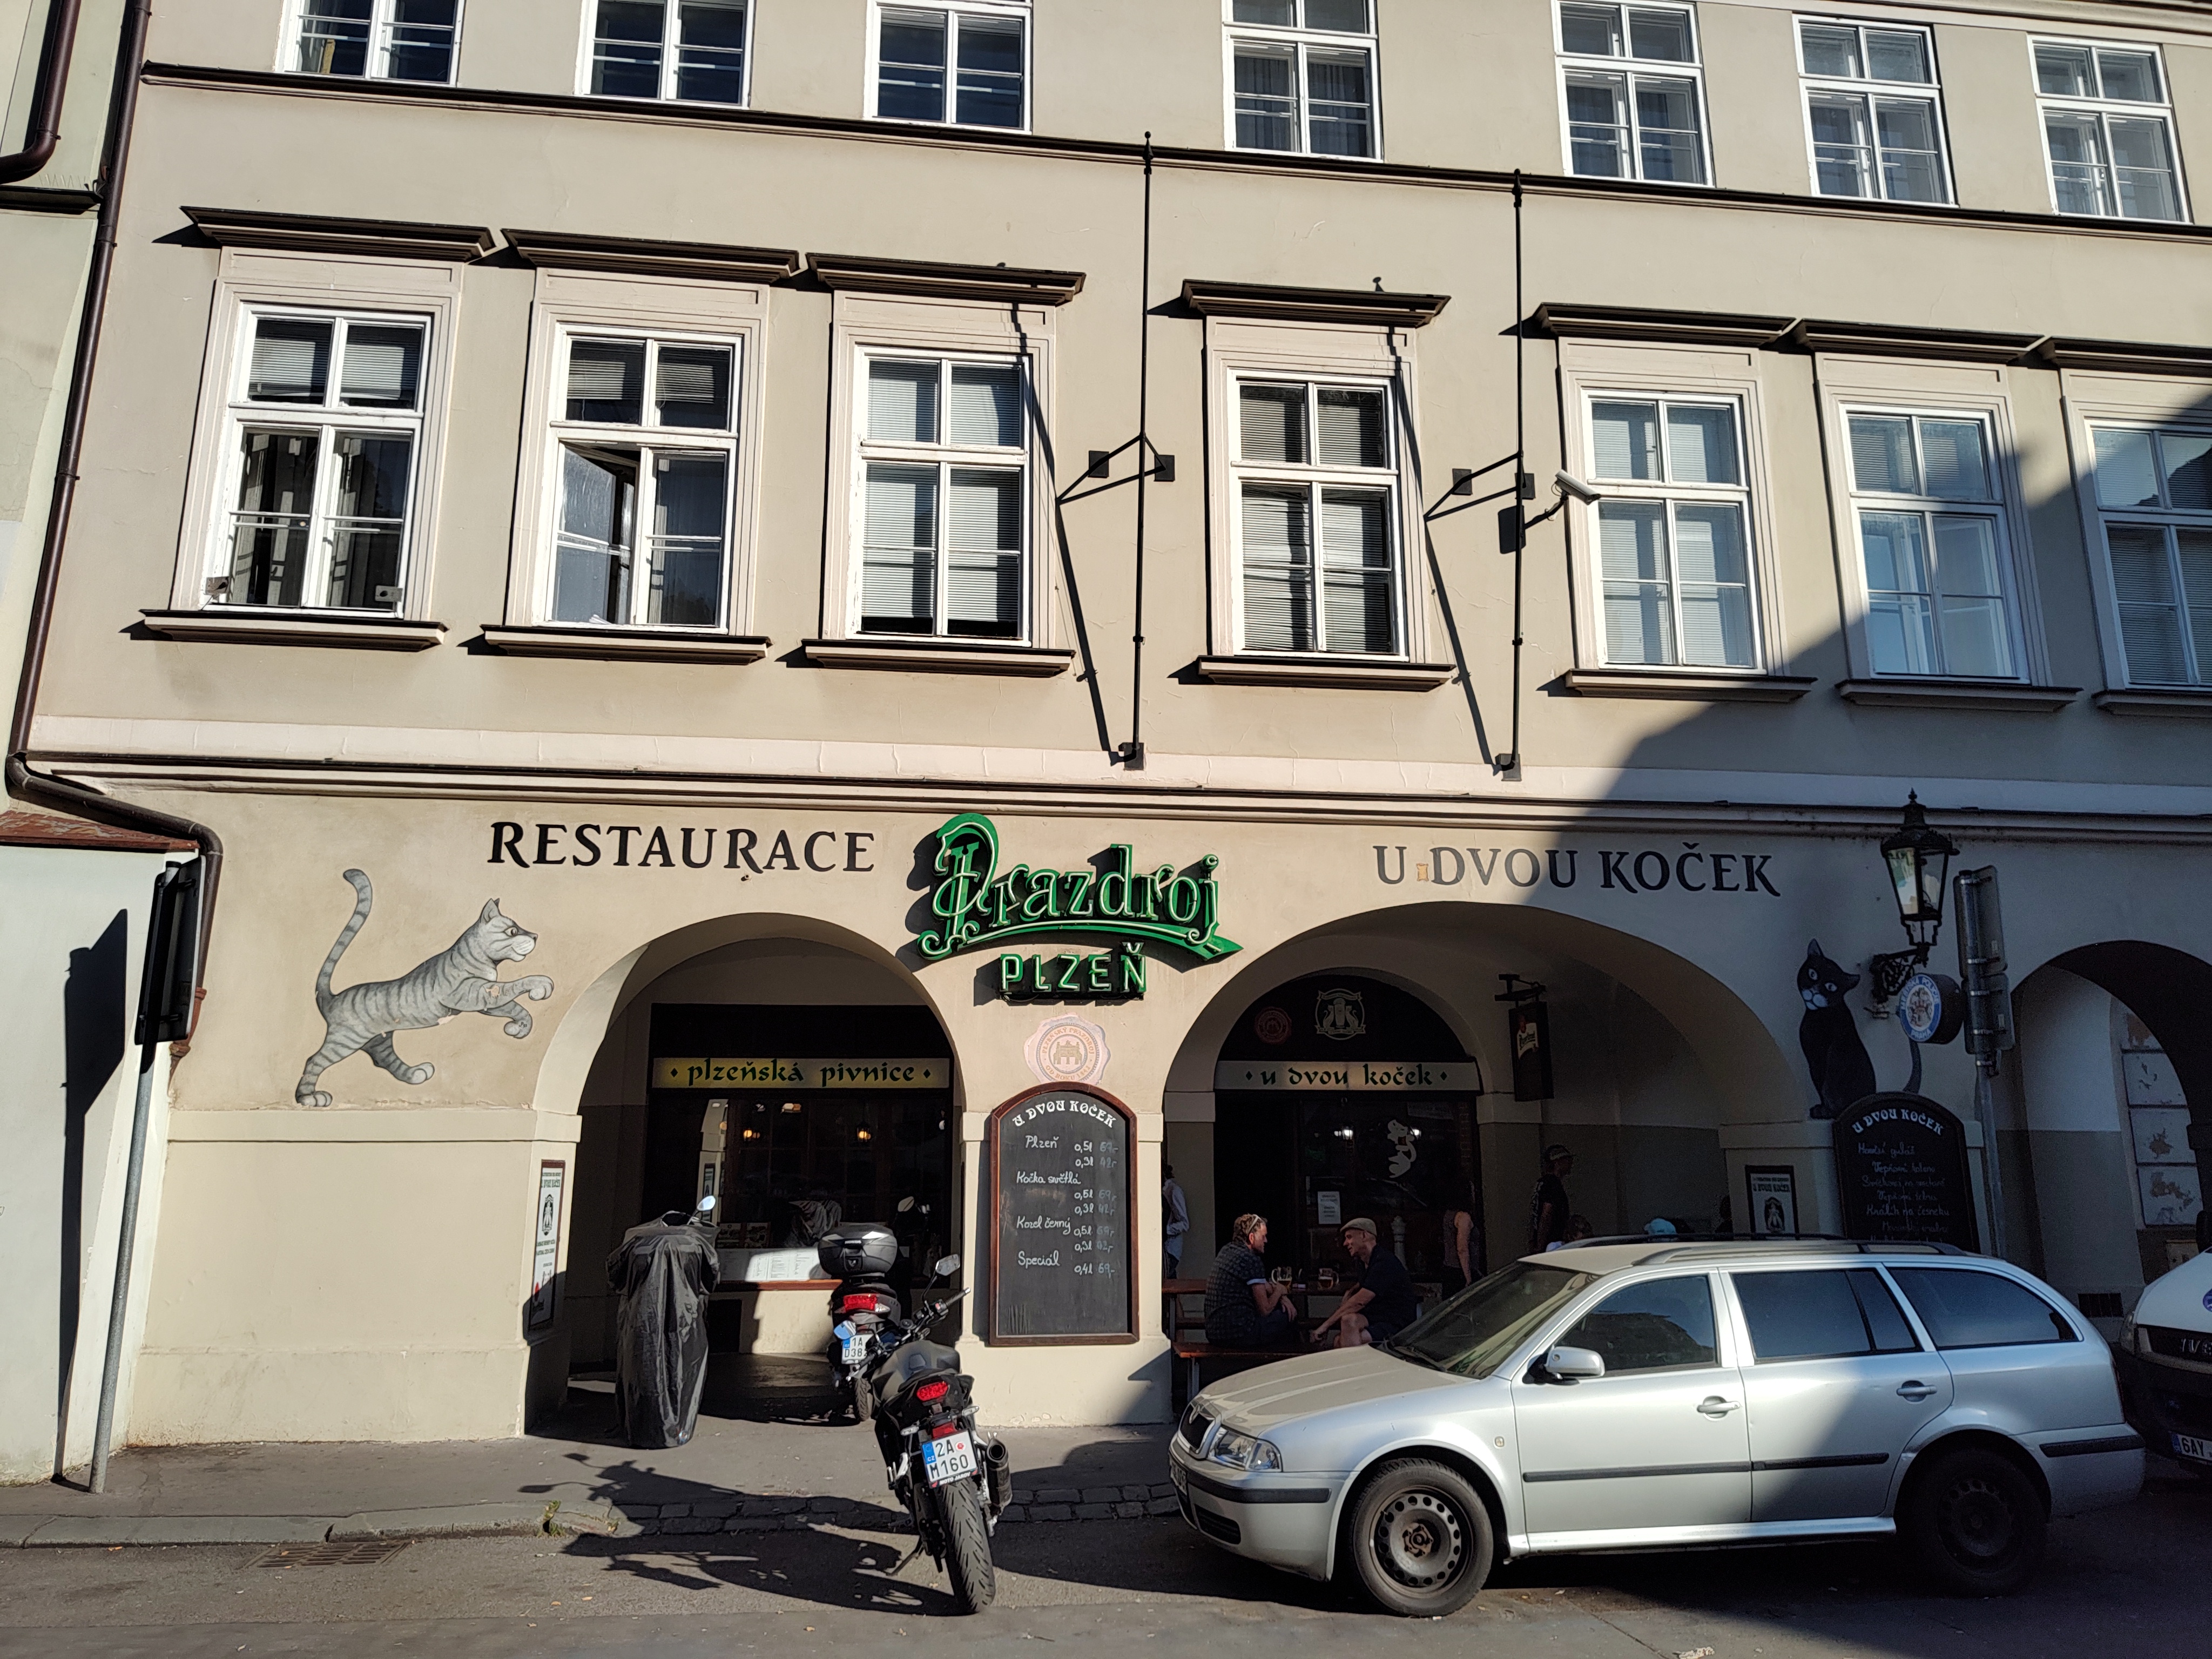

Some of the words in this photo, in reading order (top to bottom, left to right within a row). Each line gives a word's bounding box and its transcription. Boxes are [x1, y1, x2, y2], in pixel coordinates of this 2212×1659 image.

[487, 821, 874, 874] RESTAURACE
[1373, 845, 1407, 885] U
[1429, 846, 1579, 888] DVOU
[1598, 842, 1781, 897] KOČEK
[918, 813, 1220, 960] Prazdroj
[1000, 942, 1147, 993] PLZEŇ
[1042, 1027, 1067, 1054] PLZEŇSKÝ
[1069, 1027, 1095, 1054] PRAZDROJ
[1911, 1028, 1932, 1040] PRAHA
[687, 1058, 804, 1086] plzeňská
[820, 1062, 915, 1087] pivnice
[1046, 1065, 1054, 1075] OD
[1055, 1073, 1075, 1081] ROKU
[1260, 1070, 1276, 1085] u
[1289, 1067, 1348, 1085] dvou
[1363, 1064, 1433, 1086] koček
[1012, 1117, 1025, 1128] U
[1029, 1100, 1065, 1120] DVOU
[1070, 1100, 1117, 1129] KOČEK
[1851, 1122, 1864, 1134] U
[1863, 1109, 1898, 1127] DVOU
[1900, 1109, 1944, 1136] KOČEK
[1025, 1135, 1060, 1149] Plzeň
[1074, 1140, 1092, 1154] 0,5l
[1075, 1156, 1094, 1169] 0,3l
[1016, 1171, 1046, 1184] Kočka
[1048, 1171, 1082, 1184] světlá
[1074, 1189, 1094, 1201] 0,5l
[1074, 1203, 1094, 1216] 0,3l
[1016, 1215, 1042, 1229] Kozel
[1044, 1216, 1071, 1236] černý
[1074, 1225, 1092, 1238] 0,5l
[1074, 1240, 1092, 1253] 0,3l
[1017, 1250, 1060, 1269] Speciál
[1074, 1262, 1093, 1276] 0,4l
[852, 1337, 863, 1346] 1A
[935, 1439, 955, 1458] 2A
[2182, 1437, 2204, 1456] 6AY
[929, 1454, 969, 1479] M160
[939, 1476, 954, 1486] MOTO
[954, 1472, 971, 1480] JAROV
